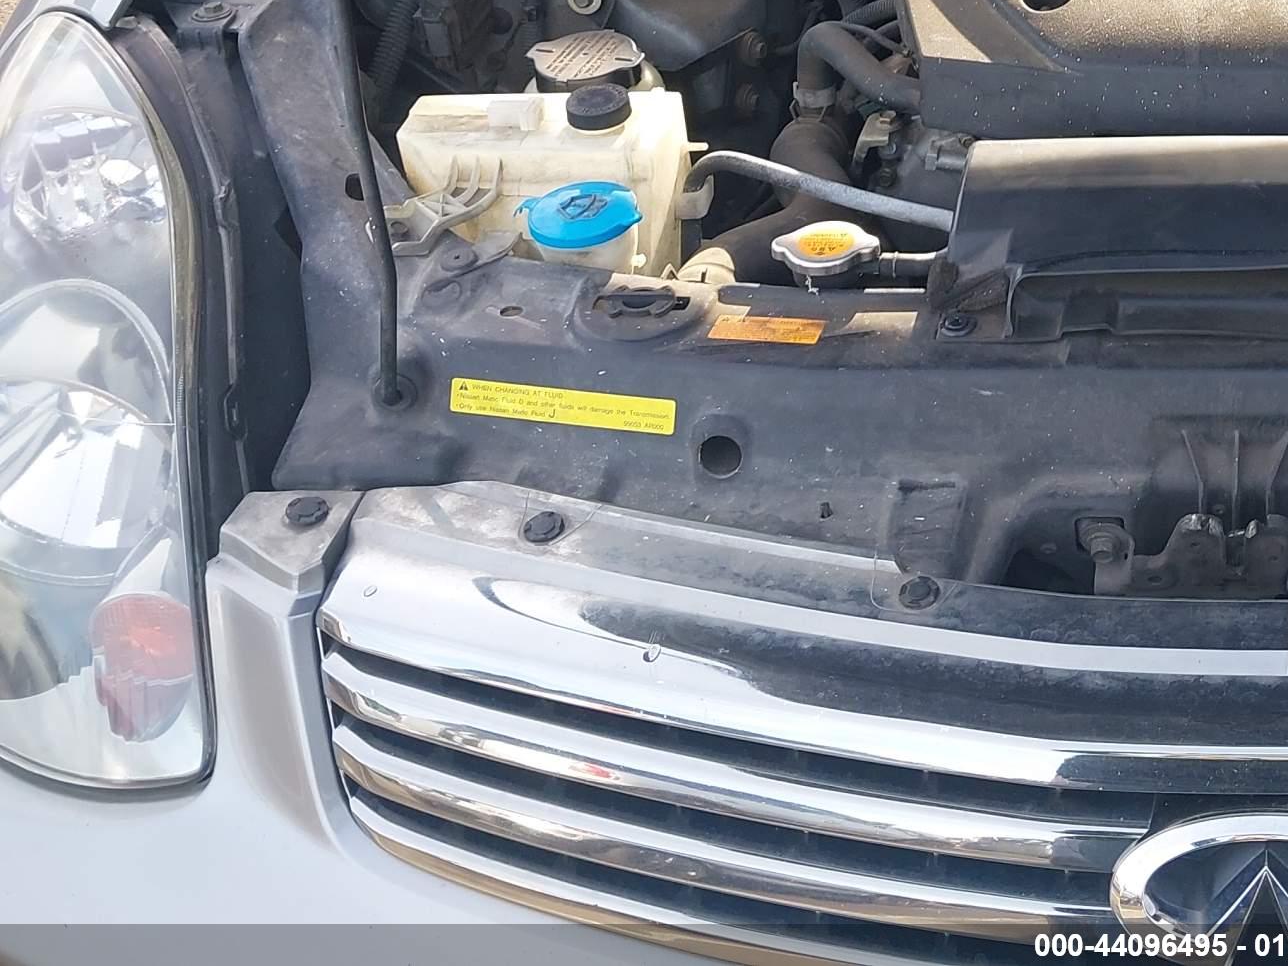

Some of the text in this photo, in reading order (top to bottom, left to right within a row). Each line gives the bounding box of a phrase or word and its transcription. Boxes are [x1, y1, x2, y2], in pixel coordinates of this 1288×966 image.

[495, 386, 530, 395] CHANGING
[544, 391, 563, 399] FLUID
[548, 408, 555, 418] J
